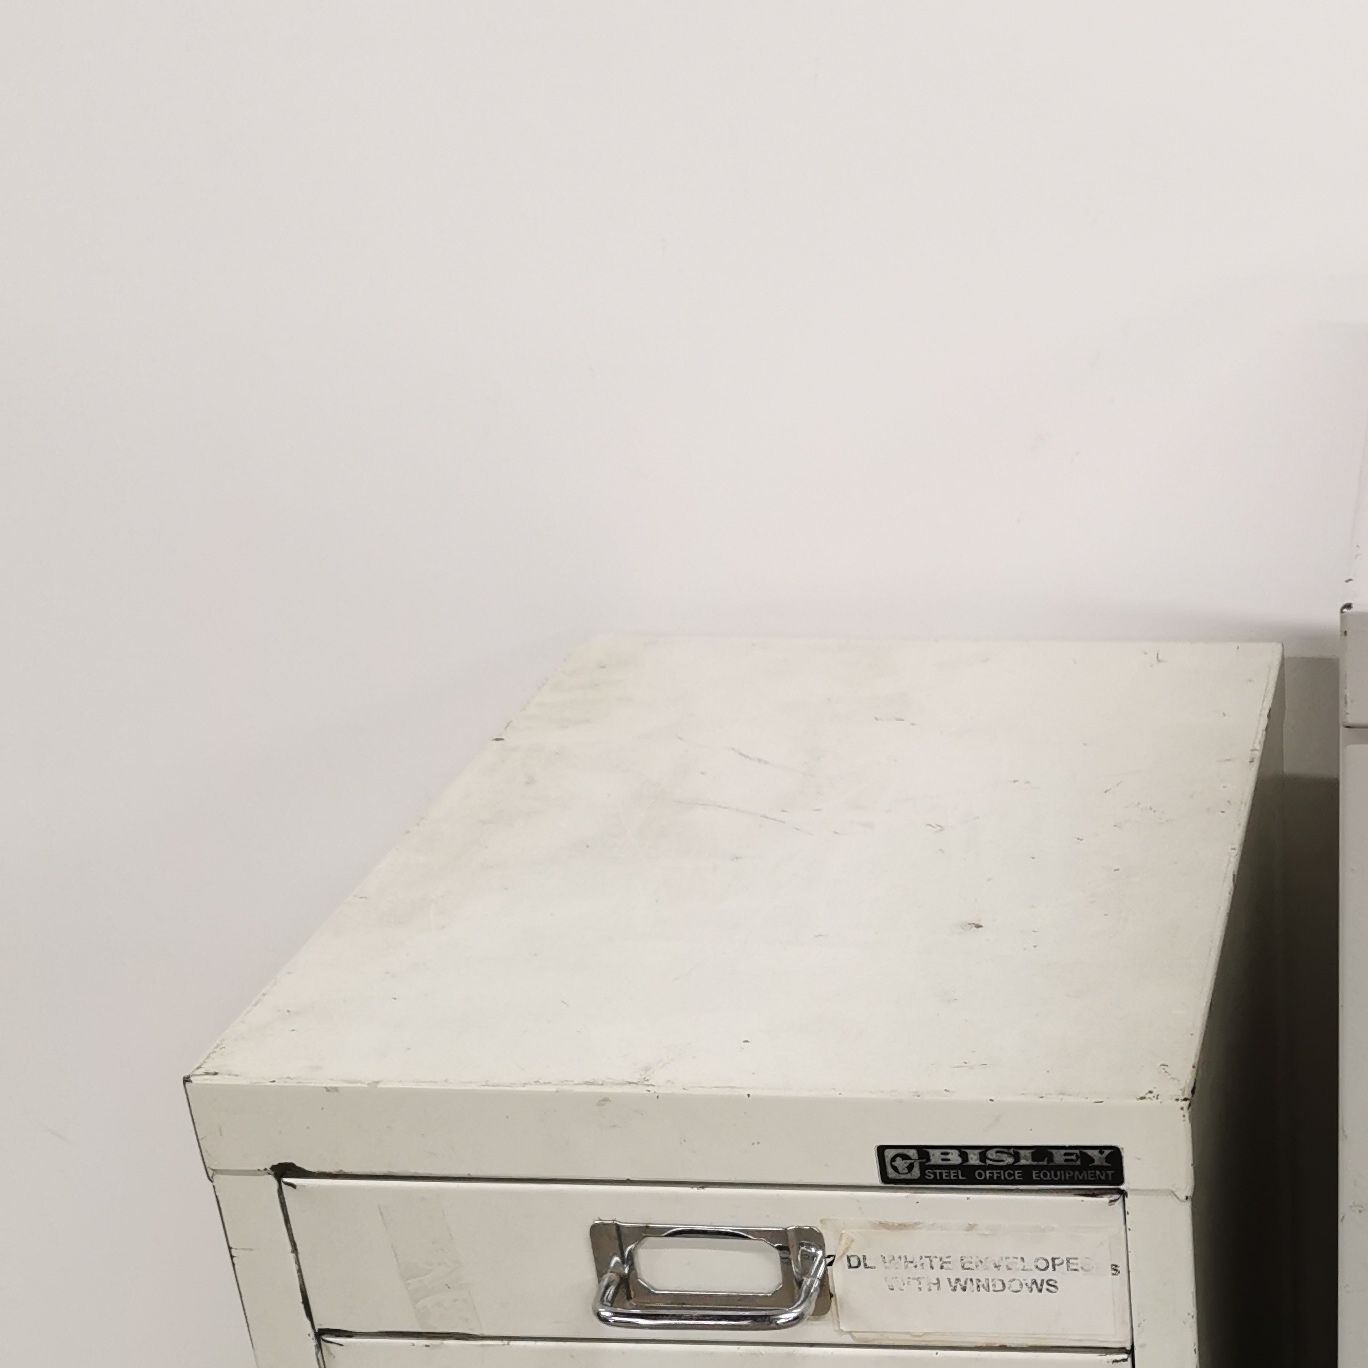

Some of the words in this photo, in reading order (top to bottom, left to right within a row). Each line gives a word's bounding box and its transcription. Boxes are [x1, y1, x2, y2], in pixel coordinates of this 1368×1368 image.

[925, 1148, 1116, 1166] BISLEY
[925, 1170, 966, 1180] STEEL
[975, 1170, 1023, 1181] OFFICE
[1032, 1170, 1115, 1181] EQUIPMENT
[846, 1254, 876, 1270] DL
[880, 1254, 953, 1271] WHITE
[946, 1277, 1060, 1294] WINDOWS
